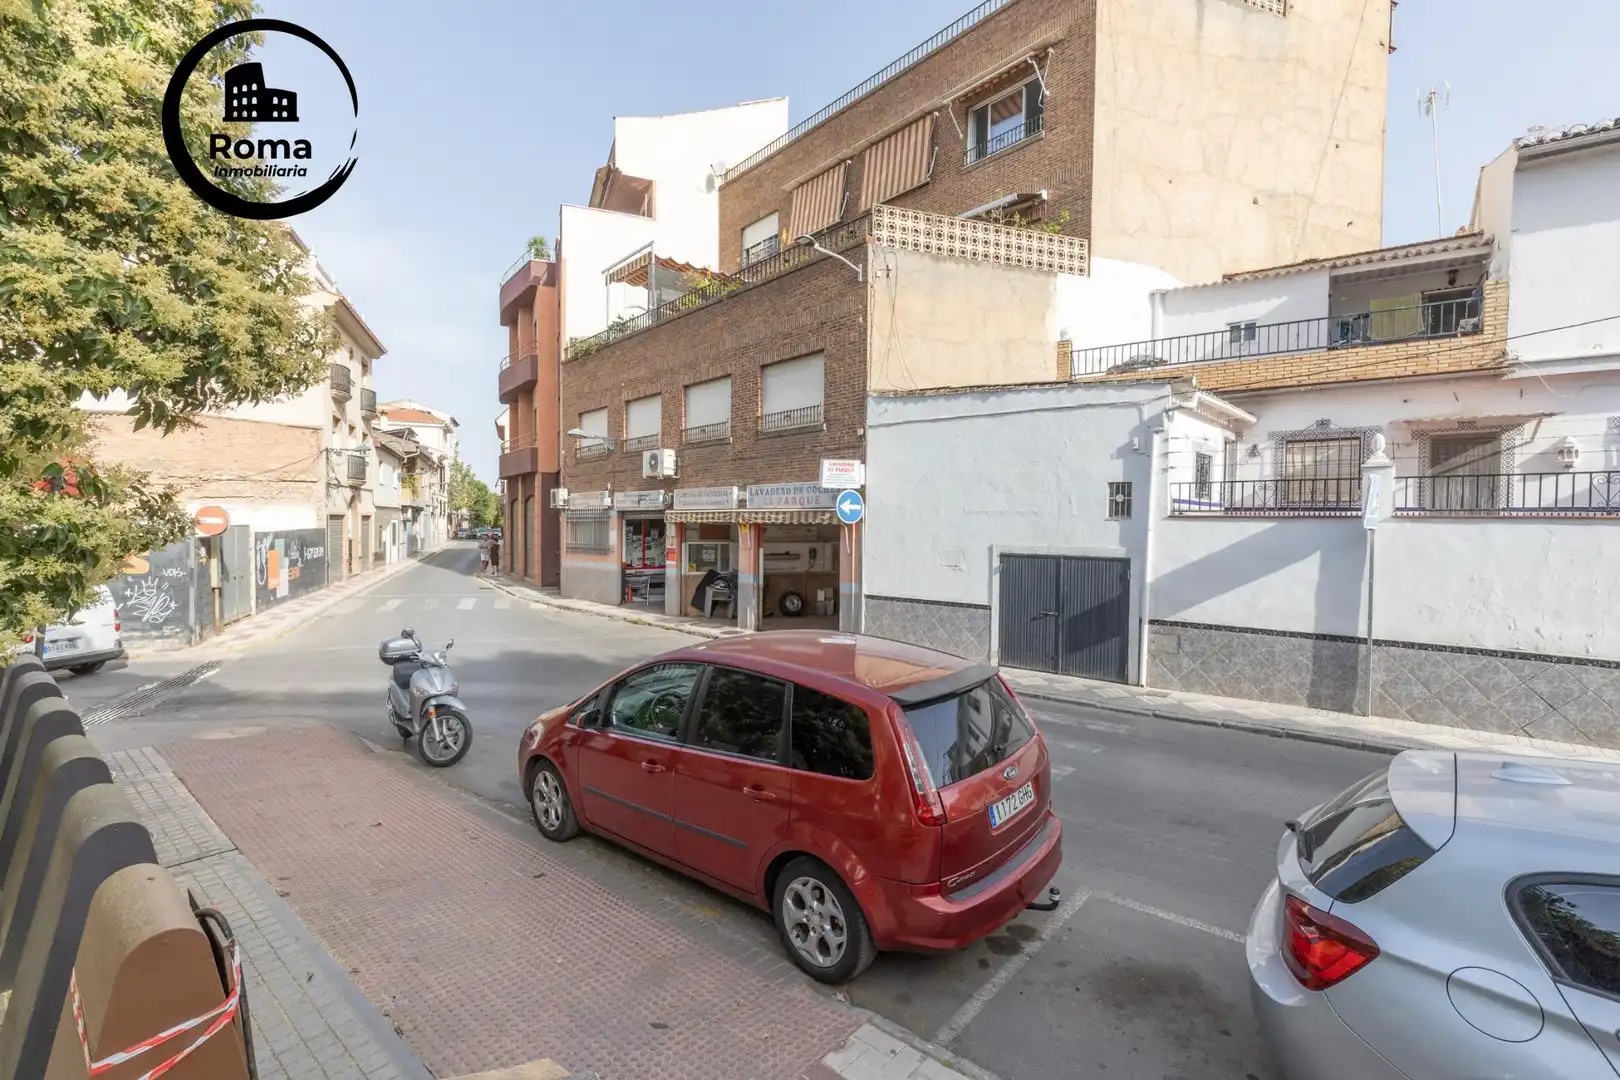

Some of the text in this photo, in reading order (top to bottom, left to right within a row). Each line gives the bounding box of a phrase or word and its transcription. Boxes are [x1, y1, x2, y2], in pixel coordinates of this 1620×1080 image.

[749, 486, 791, 497] LAVADERO
[793, 486, 803, 495] DE
[763, 495, 822, 507] EL PARQUE
[995, 784, 1033, 821] 1172 GHG
